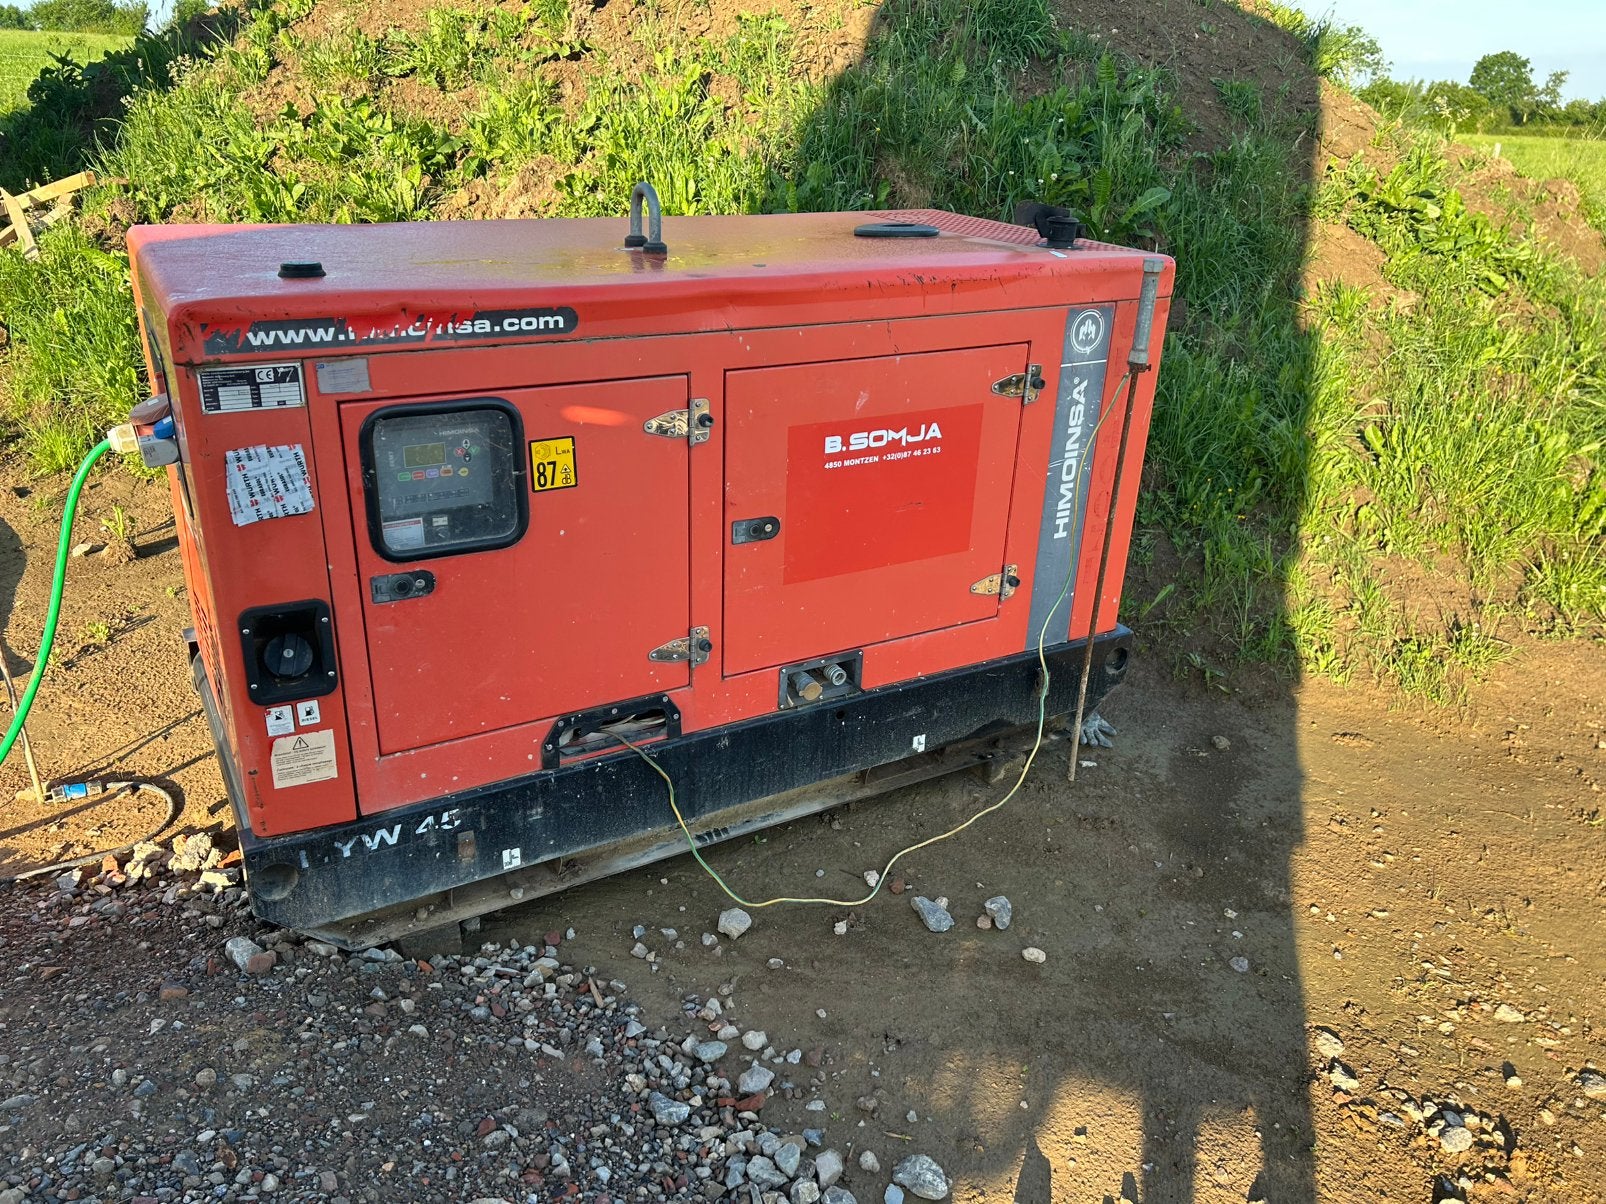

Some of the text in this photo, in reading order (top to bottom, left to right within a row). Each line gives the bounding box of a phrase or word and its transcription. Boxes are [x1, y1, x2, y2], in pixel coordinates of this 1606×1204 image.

[824, 422, 943, 454] B.SOMJA
[824, 461, 842, 470] 4850
[843, 455, 879, 467] MONTZEN
[922, 447, 932, 455] 23
[536, 460, 557, 488] 87
